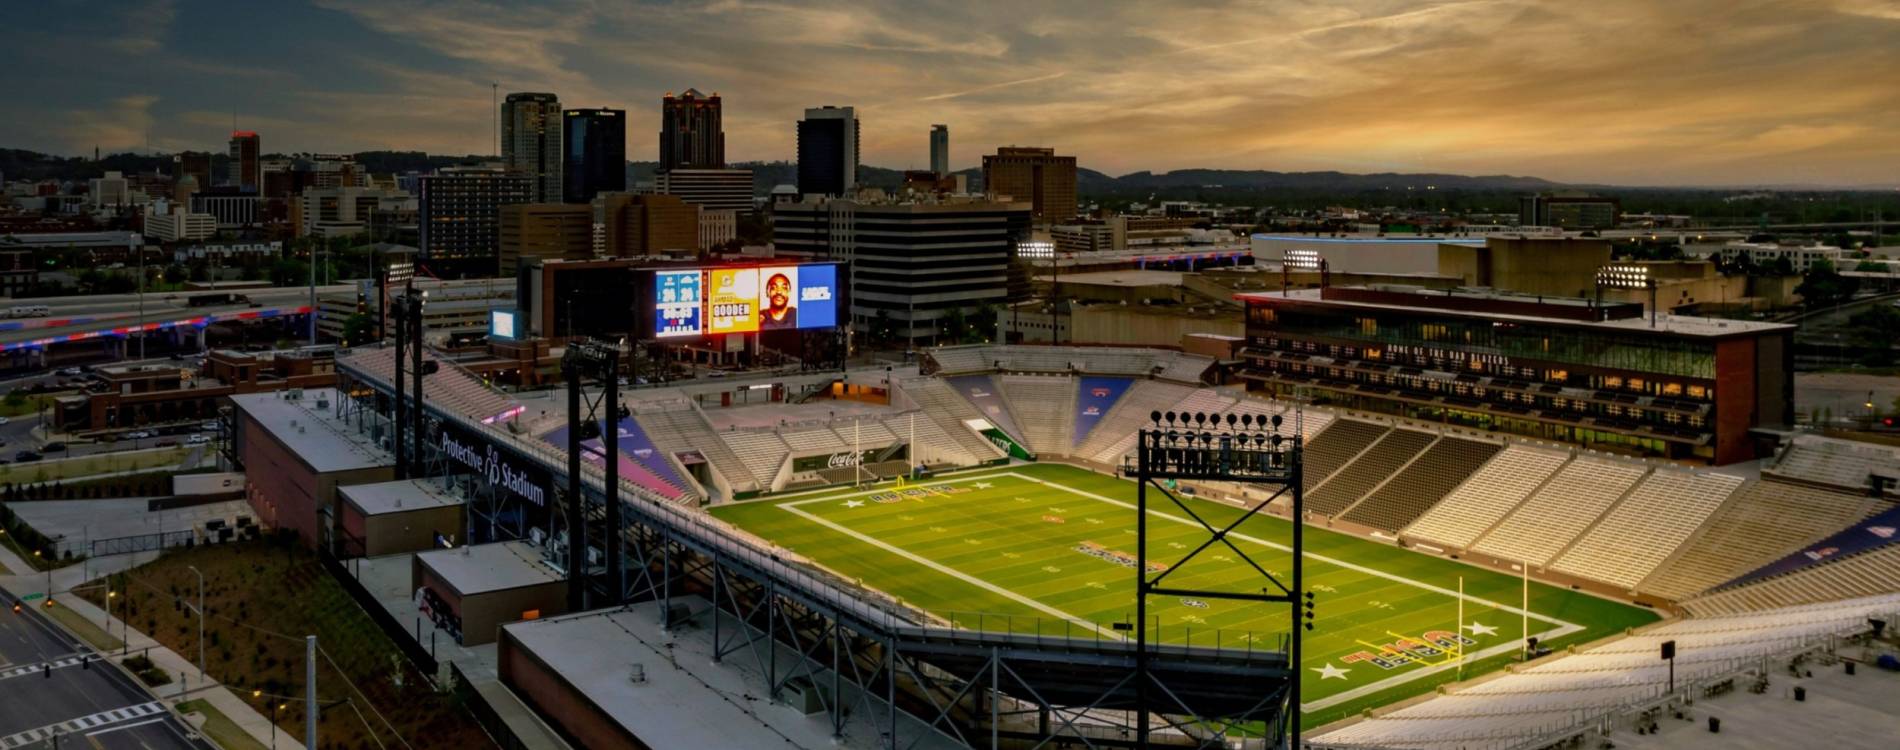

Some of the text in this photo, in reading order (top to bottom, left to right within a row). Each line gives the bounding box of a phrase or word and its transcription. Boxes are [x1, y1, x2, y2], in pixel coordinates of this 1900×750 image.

[1387, 343, 1408, 355] HOME
[1413, 346, 1423, 356] OF
[1429, 348, 1444, 359] THE
[1471, 353, 1509, 365] BLAZERS
[442, 431, 545, 507] Protective Stadium
